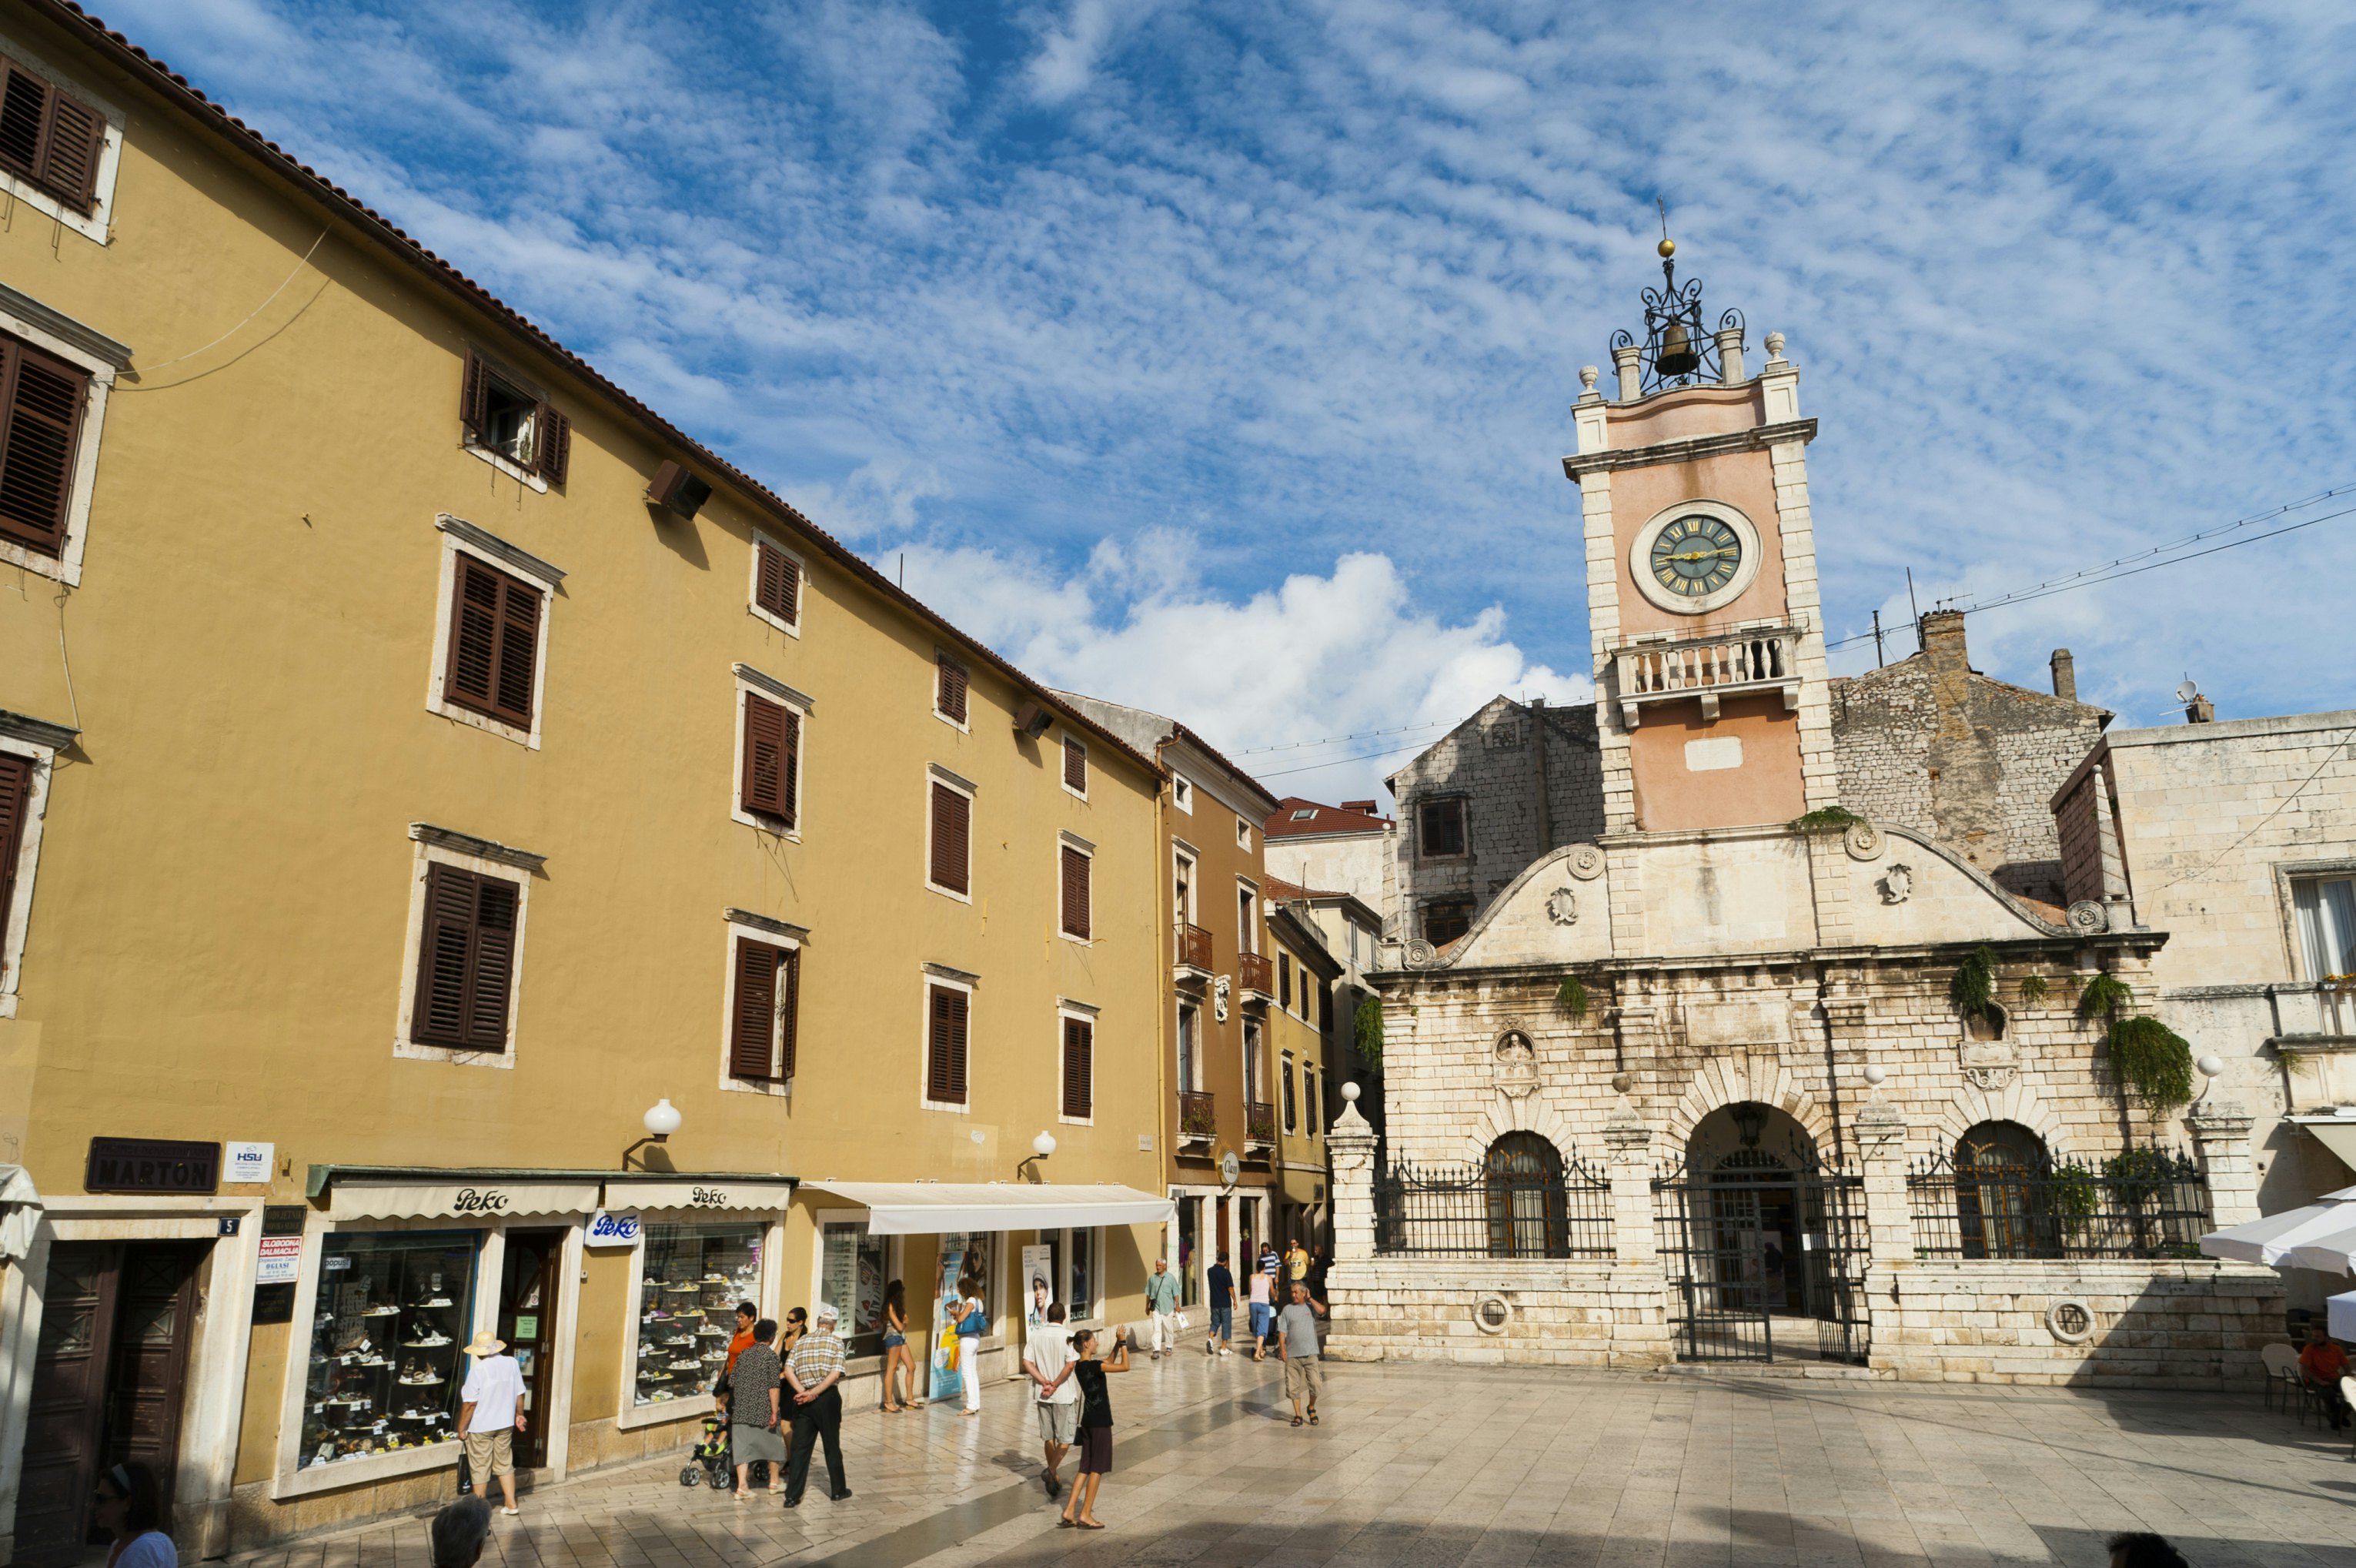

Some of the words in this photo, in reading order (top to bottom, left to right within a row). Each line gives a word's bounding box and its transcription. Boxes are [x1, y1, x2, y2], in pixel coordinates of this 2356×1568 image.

[1687, 520, 1698, 532] XII
[1669, 526, 1683, 539] XI
[1718, 533, 1730, 542] II
[1719, 563, 1733, 573] IV
[1661, 568, 1676, 583] VIII
[1710, 576, 1719, 585] V
[1675, 579, 1688, 592] VII
[1694, 581, 1703, 592] VI
[99, 1159, 209, 1186] MARTON
[1225, 1160, 1238, 1175] Class
[453, 1189, 509, 1211] Peko
[693, 1186, 727, 1204] Peko
[226, 1220, 232, 1232] 5
[593, 1214, 639, 1239] Peko
[262, 1239, 299, 1248] SLOBODNA
[1070, 1310, 1086, 1319] OLICE
